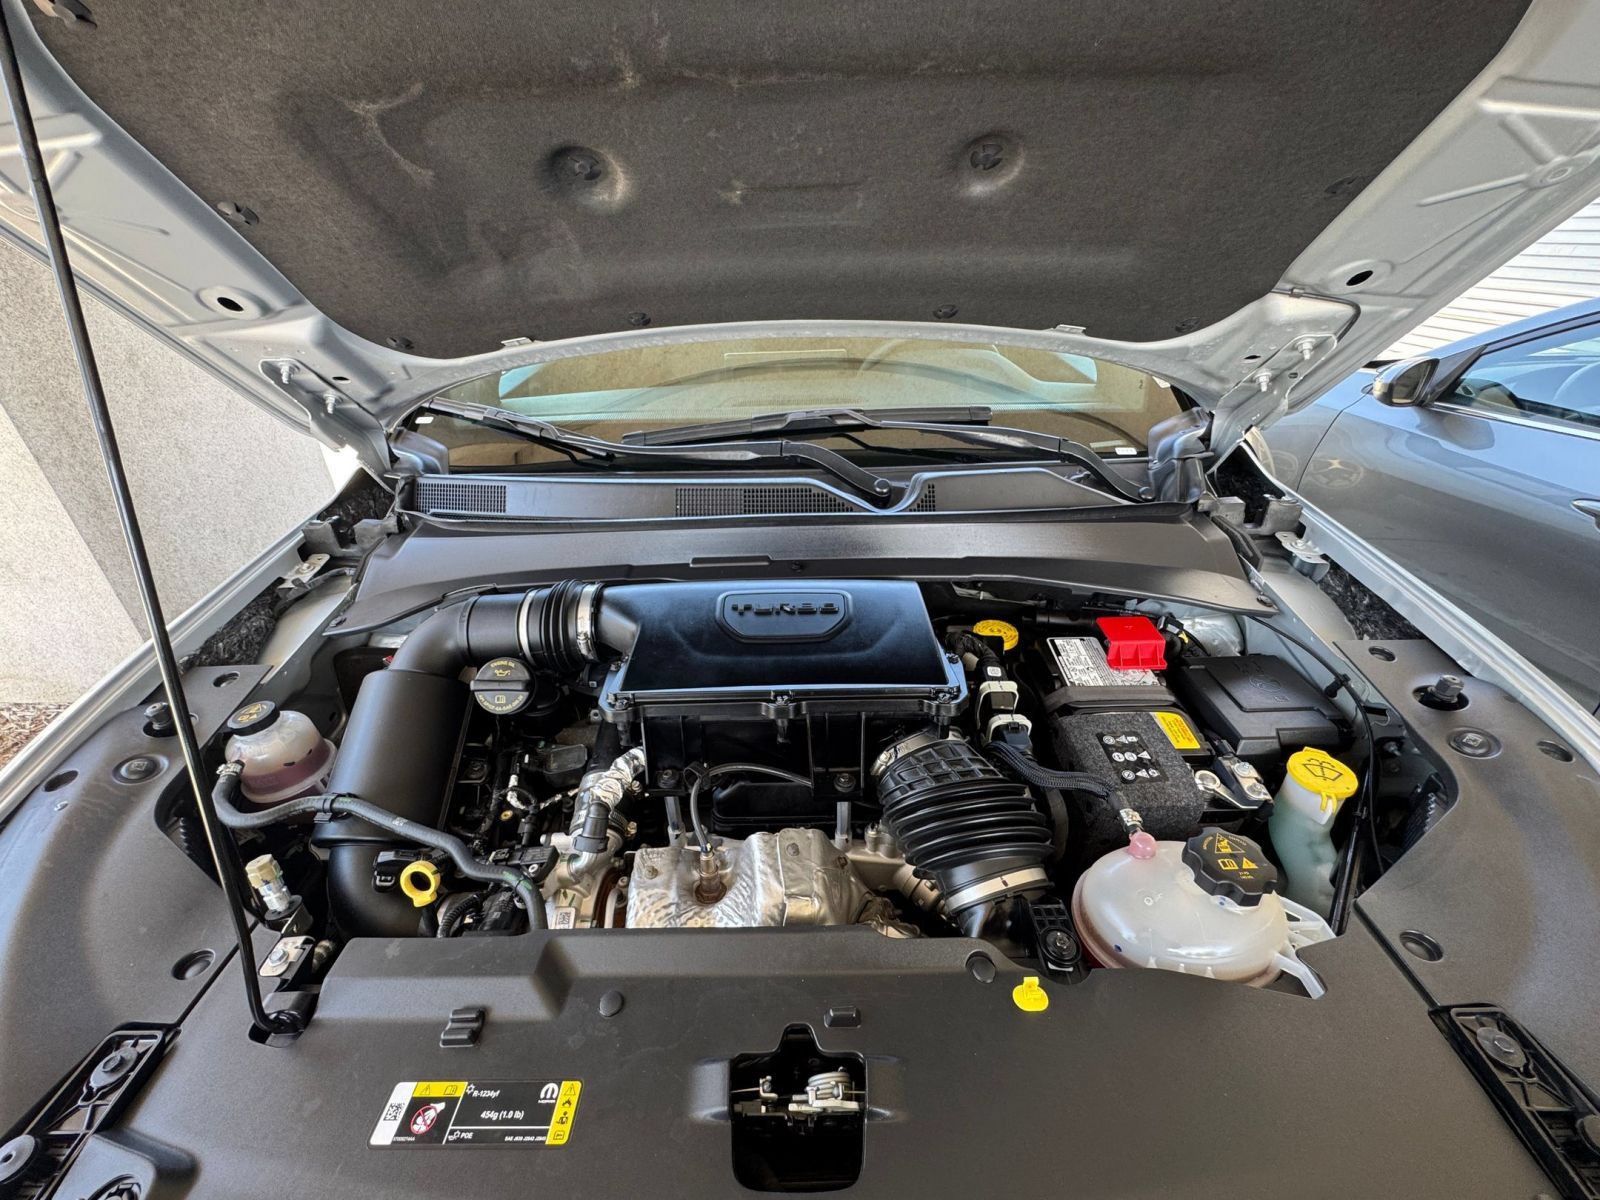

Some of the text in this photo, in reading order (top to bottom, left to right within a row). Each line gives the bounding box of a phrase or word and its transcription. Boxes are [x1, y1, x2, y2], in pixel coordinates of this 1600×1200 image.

[731, 602, 840, 616] TURBO
[472, 1090, 500, 1098] R-1234yf
[480, 1110, 524, 1120] 454g (1.0 lb)
